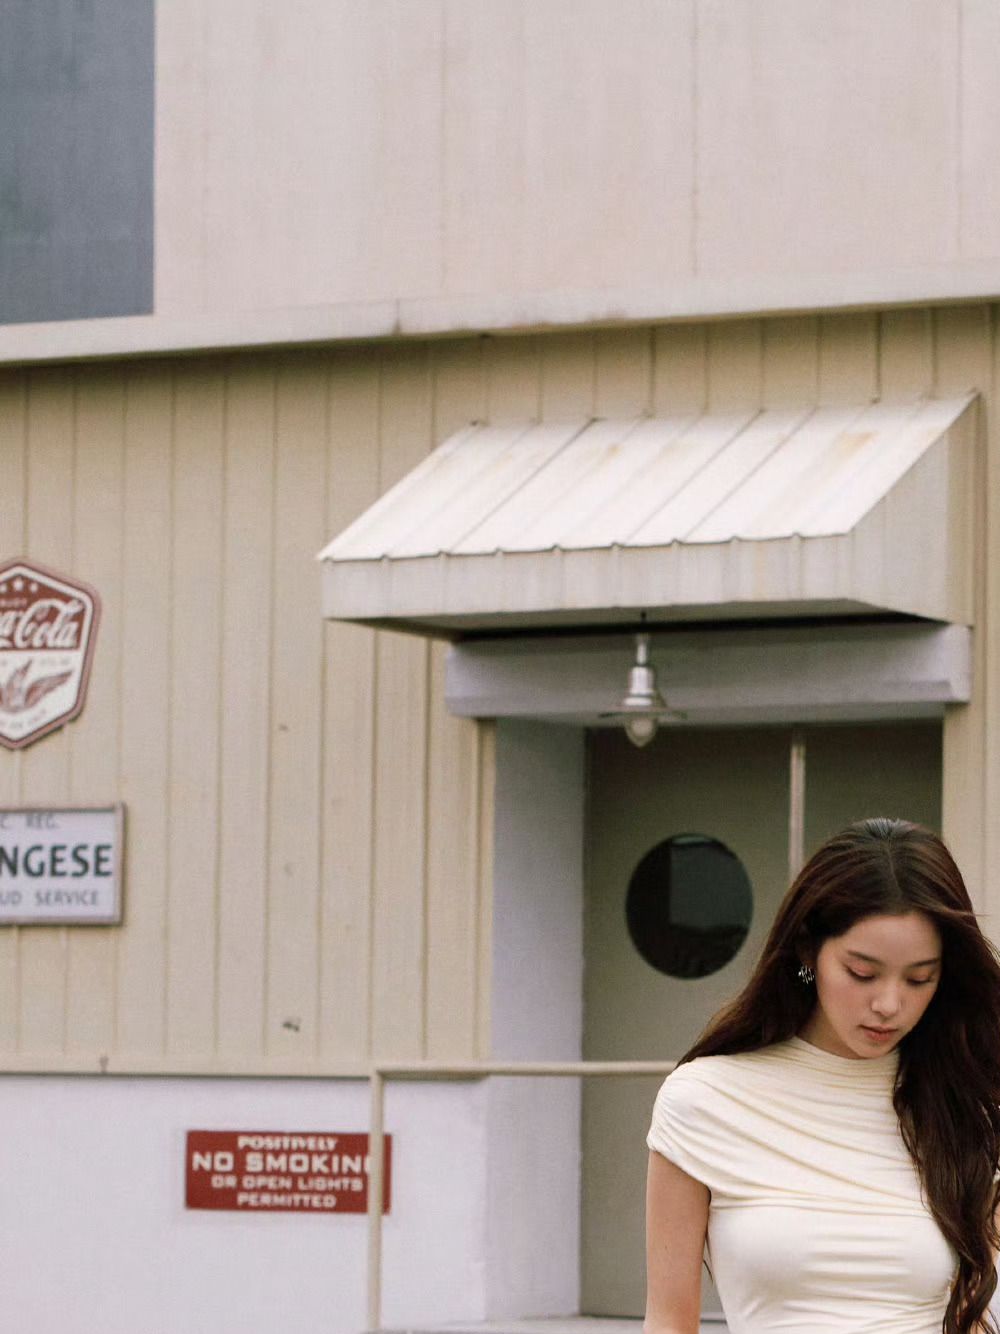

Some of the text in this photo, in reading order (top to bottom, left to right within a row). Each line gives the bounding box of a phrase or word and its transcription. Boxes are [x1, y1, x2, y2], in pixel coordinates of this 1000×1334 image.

[0, 844, 113, 878] NGESE
[237, 1135, 338, 1151] POSITIVELY
[192, 1151, 370, 1174] NO SMOKIN
[211, 1174, 363, 1193] OR OPEN LIGHTS
[236, 1191, 337, 1208] PERMITTED
